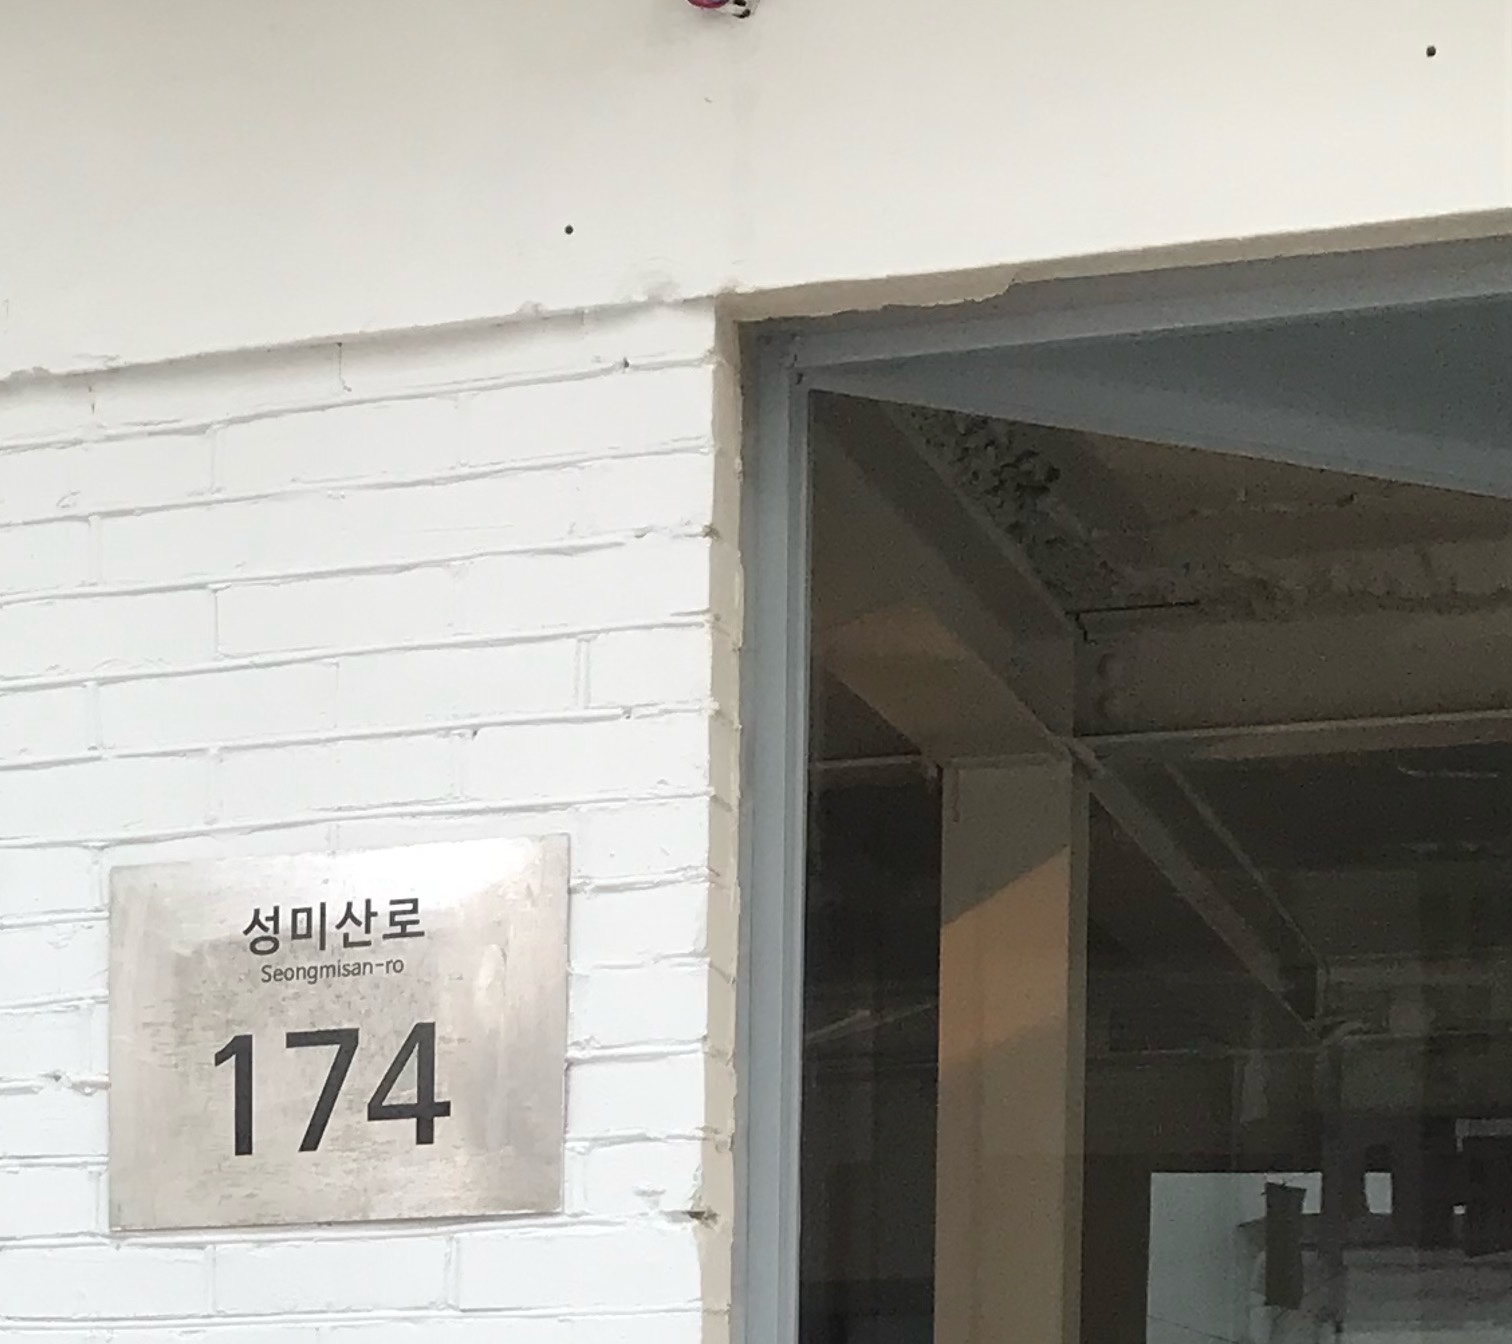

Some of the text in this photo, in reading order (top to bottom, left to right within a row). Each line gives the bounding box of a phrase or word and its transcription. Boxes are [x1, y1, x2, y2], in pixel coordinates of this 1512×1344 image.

[242, 897, 424, 956] 성미산로
[260, 957, 405, 985] Seongmisan-ro
[214, 1021, 451, 1157] 174
